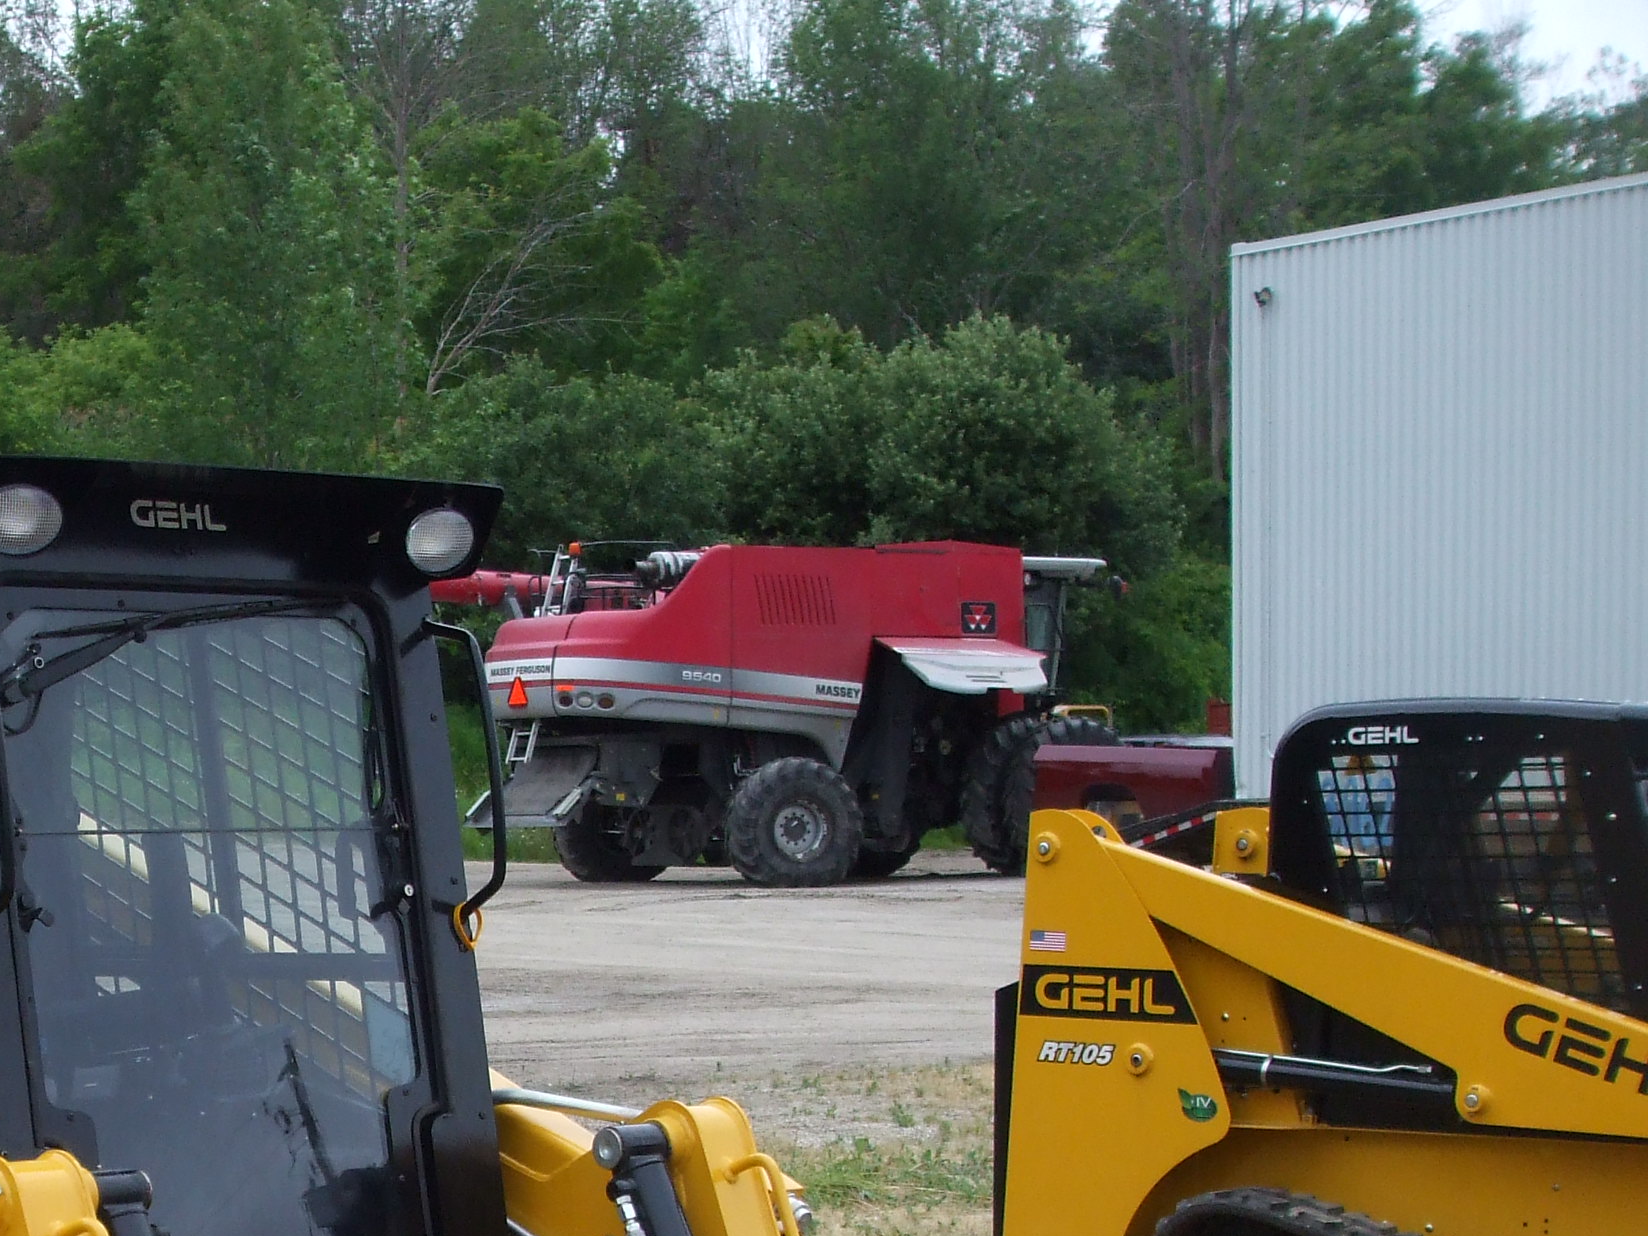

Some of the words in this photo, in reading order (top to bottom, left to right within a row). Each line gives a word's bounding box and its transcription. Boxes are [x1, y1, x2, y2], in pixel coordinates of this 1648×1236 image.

[130, 499, 227, 531] GEHL
[490, 666, 514, 676] MASSEY
[515, 664, 551, 675] FERGUSON
[682, 670, 721, 682] 9540
[815, 684, 861, 699] MASSEY
[1348, 725, 1420, 745] GEHL
[1034, 973, 1176, 1015] GEHL
[1037, 1040, 1116, 1067] RT105
[1503, 1003, 1648, 1096] GEH
